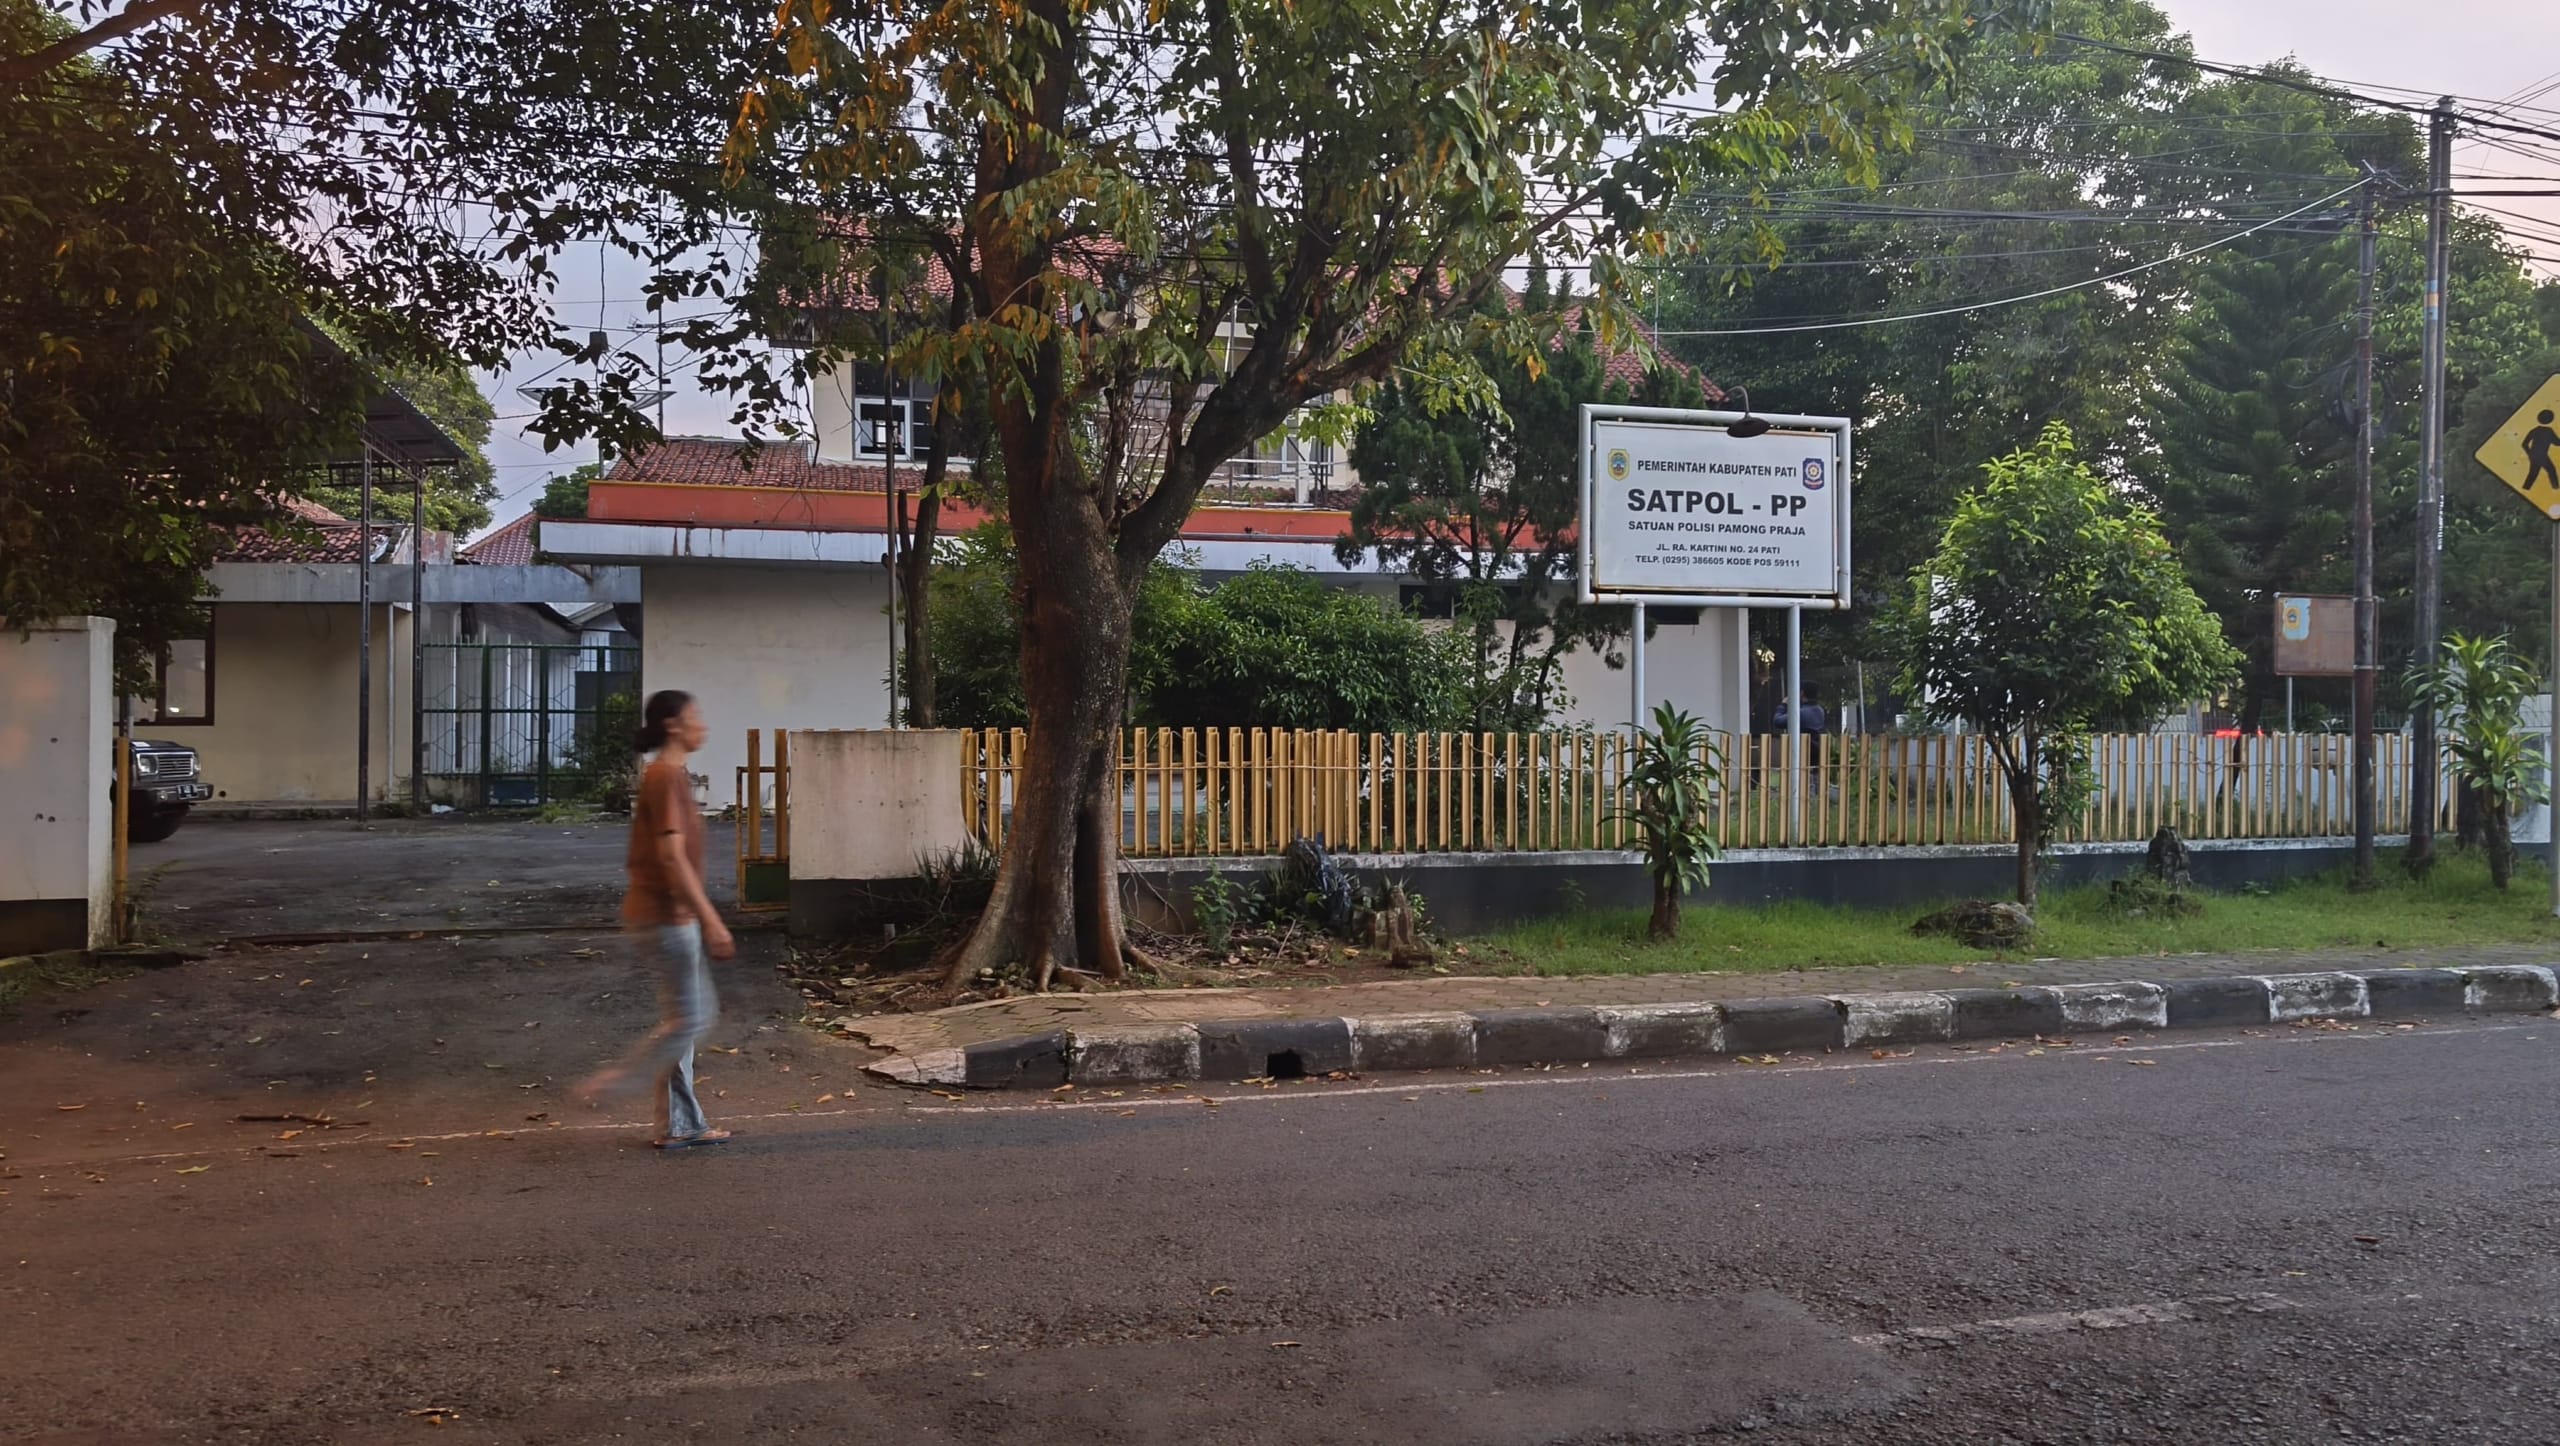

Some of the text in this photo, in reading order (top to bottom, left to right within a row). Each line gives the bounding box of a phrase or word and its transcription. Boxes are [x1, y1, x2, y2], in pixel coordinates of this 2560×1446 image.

[1638, 460, 1796, 477] PEMERINTAH KABUPATEN PATI
[1628, 489, 1743, 515] SATPOL
[1771, 495, 1806, 516] PP
[1628, 521, 1805, 536] SATUAN POLISI PAMONG PRAJA
[1690, 544, 1727, 552] KARTINI
[1662, 556, 1689, 565] (0295)
